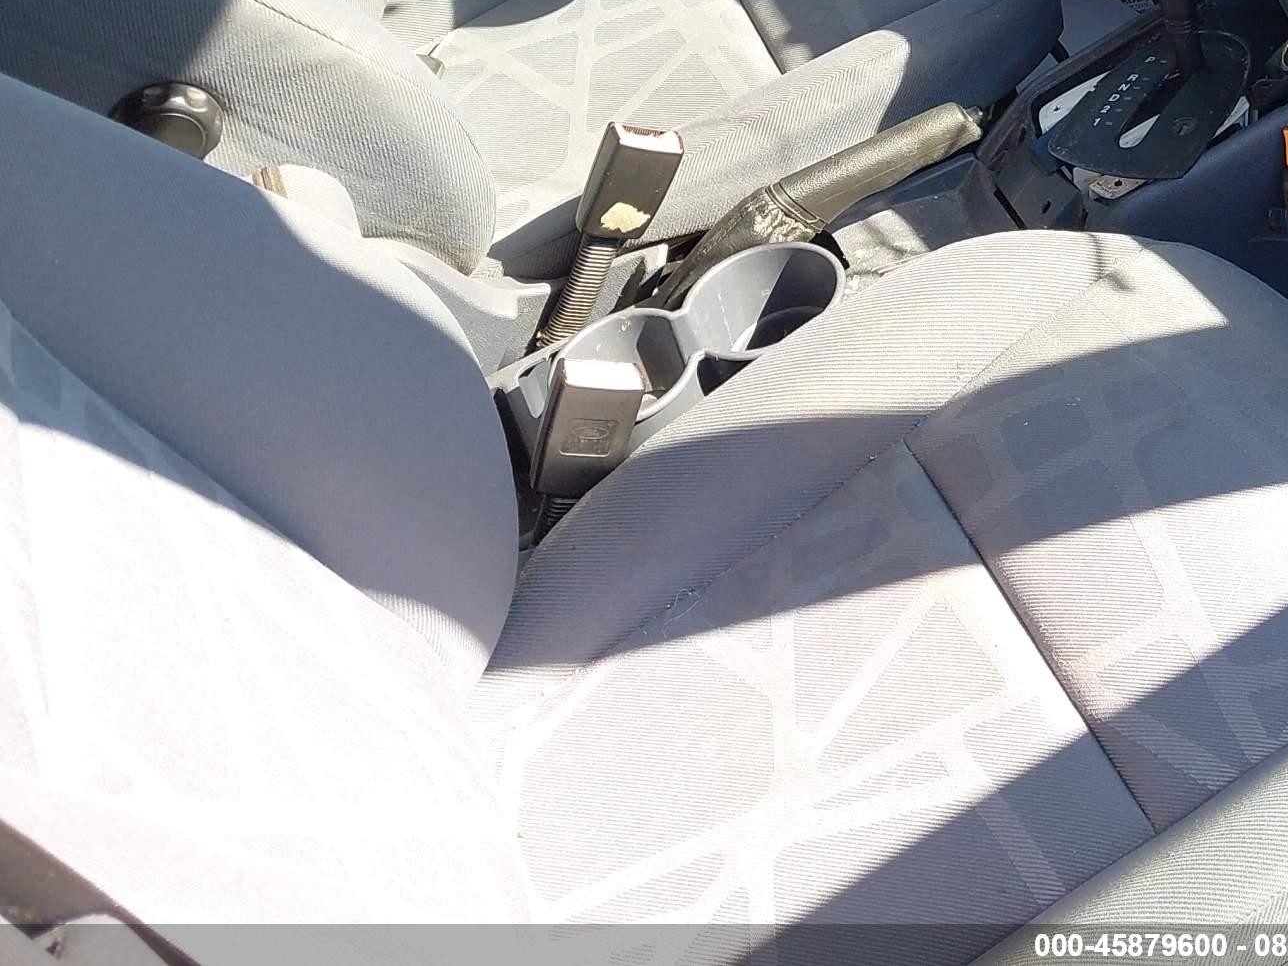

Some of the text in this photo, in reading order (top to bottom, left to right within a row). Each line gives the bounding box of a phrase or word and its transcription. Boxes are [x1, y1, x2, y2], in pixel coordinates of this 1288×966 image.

[1118, 83, 1131, 91] N
[1100, 105, 1111, 113] 2
[1093, 117, 1101, 126] 1
